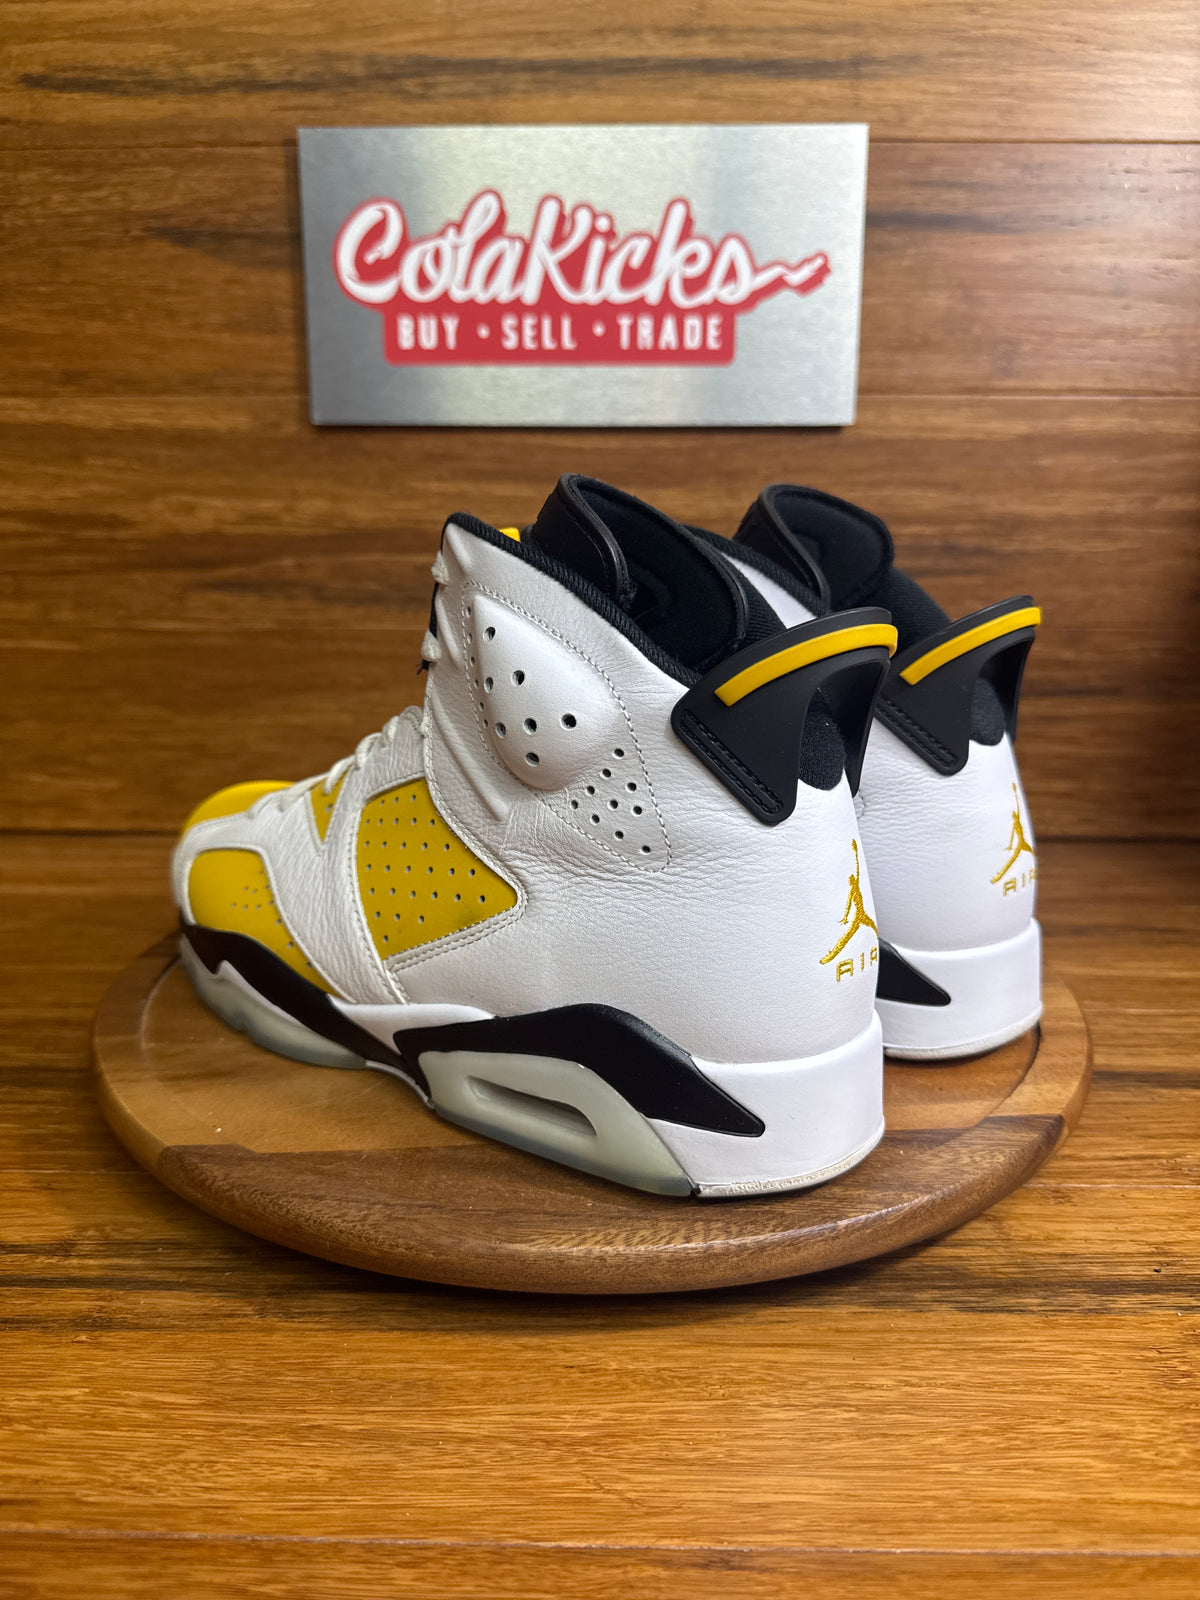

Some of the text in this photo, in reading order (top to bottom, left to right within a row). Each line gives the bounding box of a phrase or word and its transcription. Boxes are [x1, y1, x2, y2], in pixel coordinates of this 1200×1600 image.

[336, 190, 829, 308] ColaKicks
[398, 314, 724, 350] BUY SELL TRADE
